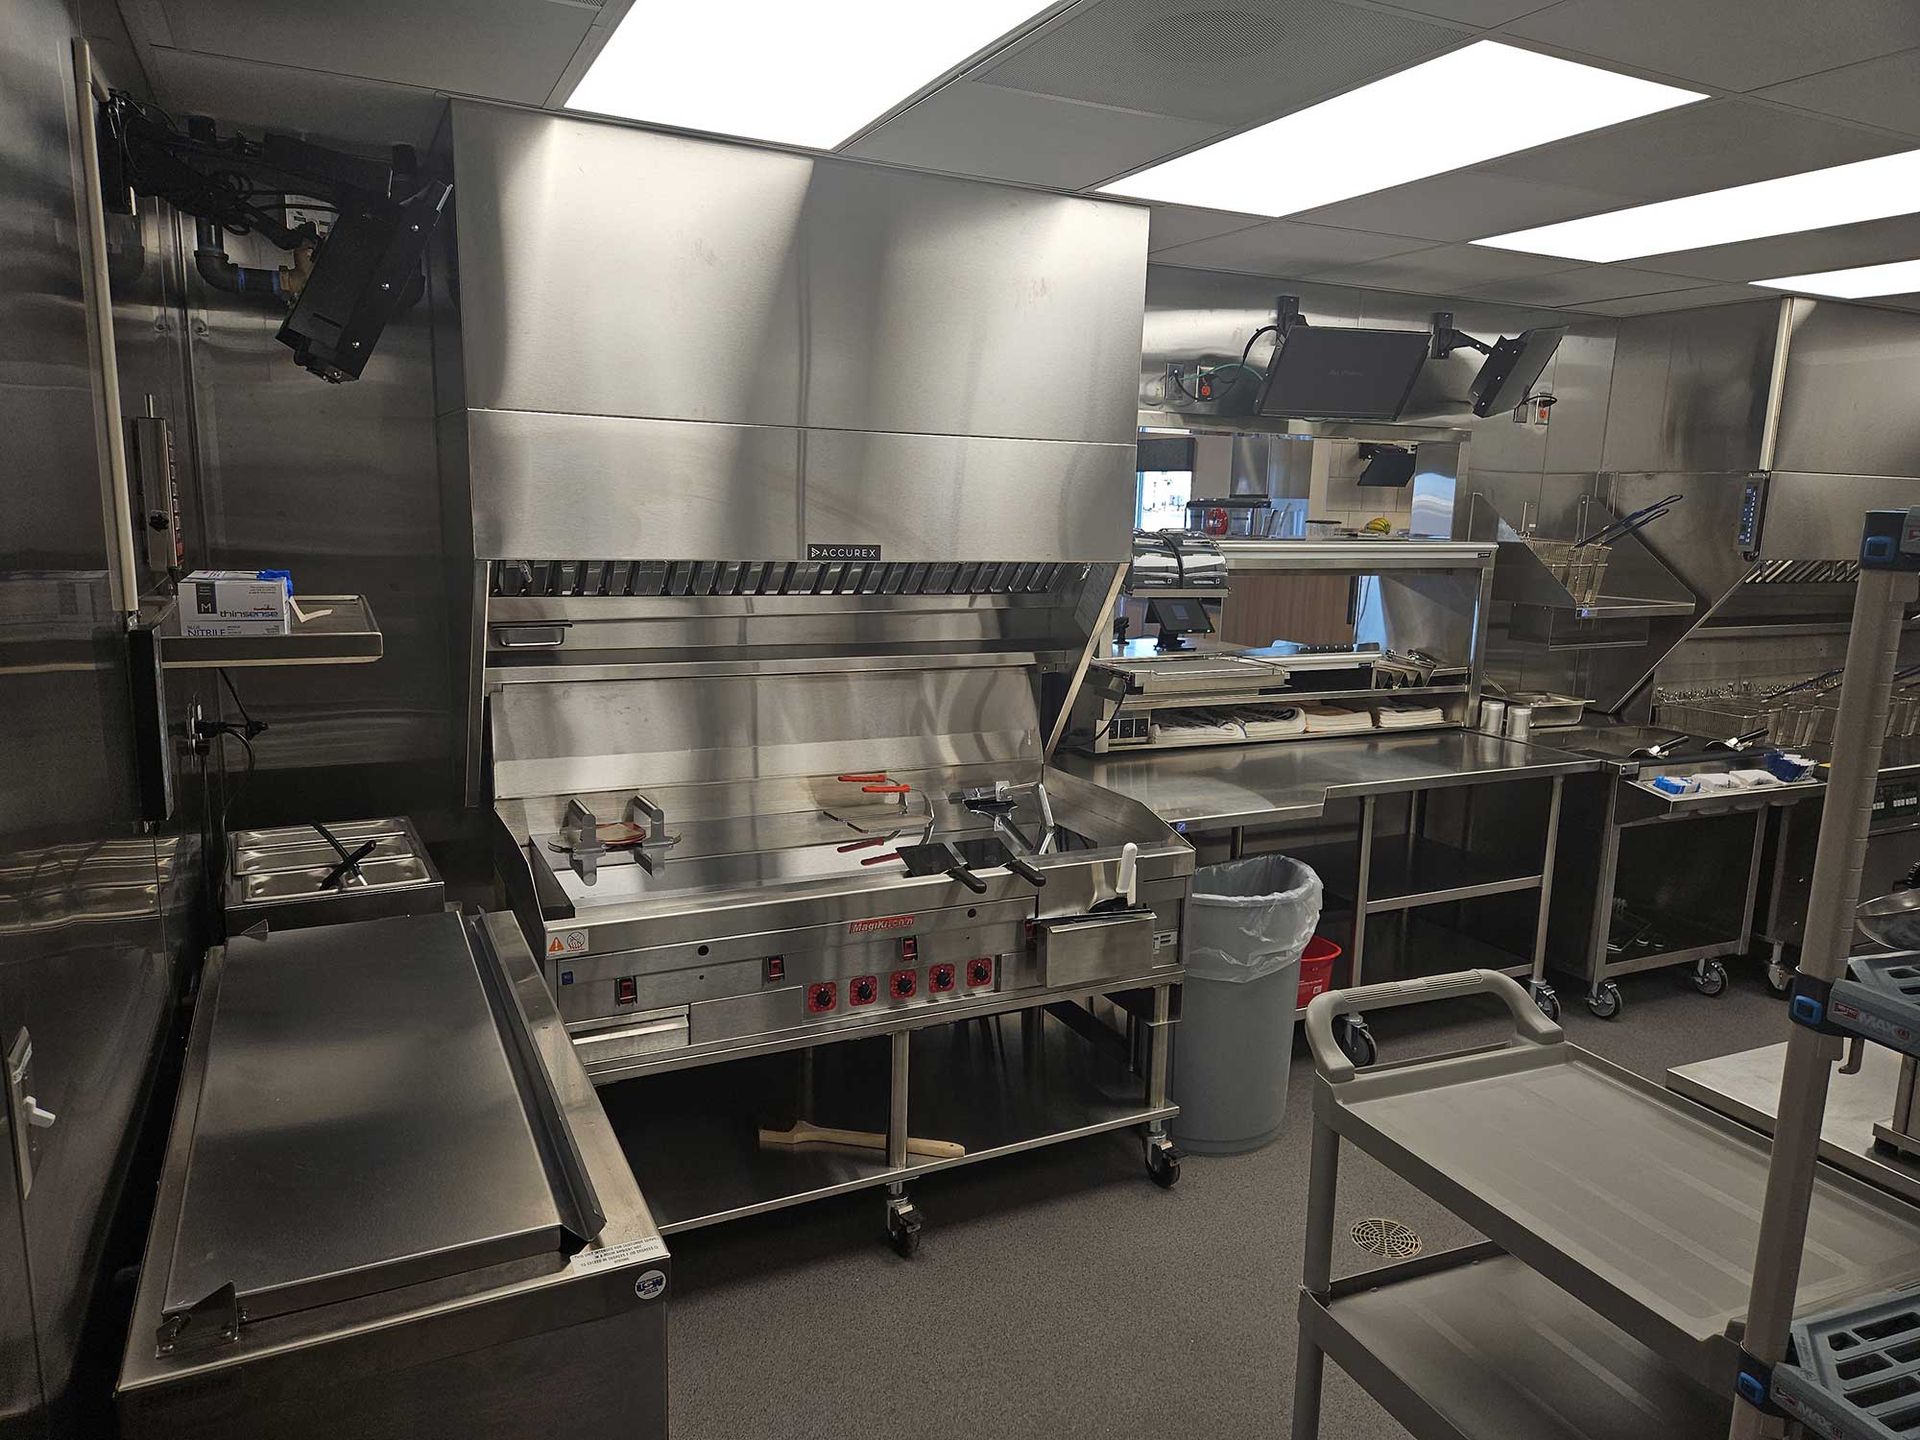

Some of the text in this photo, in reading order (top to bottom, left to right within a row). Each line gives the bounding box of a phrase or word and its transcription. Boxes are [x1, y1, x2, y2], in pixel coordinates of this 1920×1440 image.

[821, 548, 876, 558] ACCUREX
[201, 602, 212, 613] M
[219, 610, 279, 618] thinsense
[187, 629, 227, 637] NITRILE
